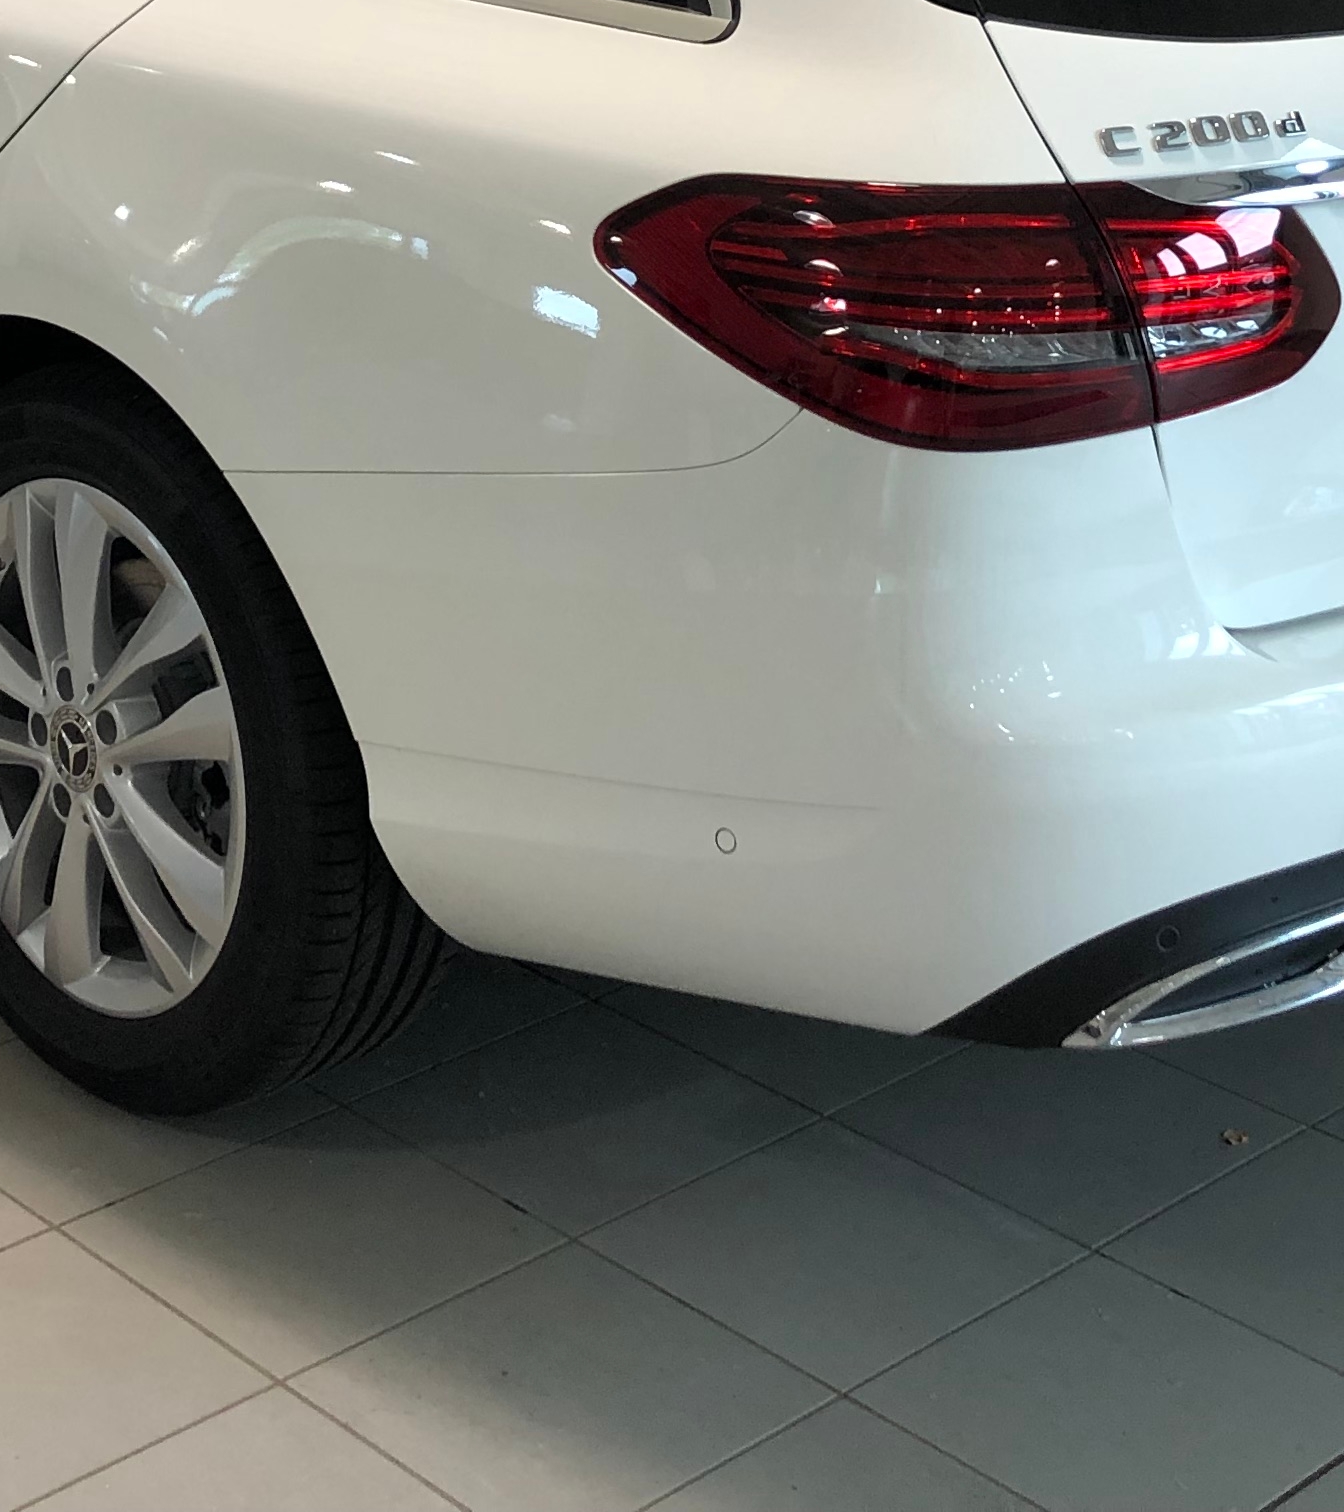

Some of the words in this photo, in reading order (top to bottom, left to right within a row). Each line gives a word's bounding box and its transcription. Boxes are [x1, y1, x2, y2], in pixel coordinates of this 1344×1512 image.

[1097, 125, 1142, 158] C
[1148, 110, 1270, 153] 200
[1273, 109, 1307, 138] d
